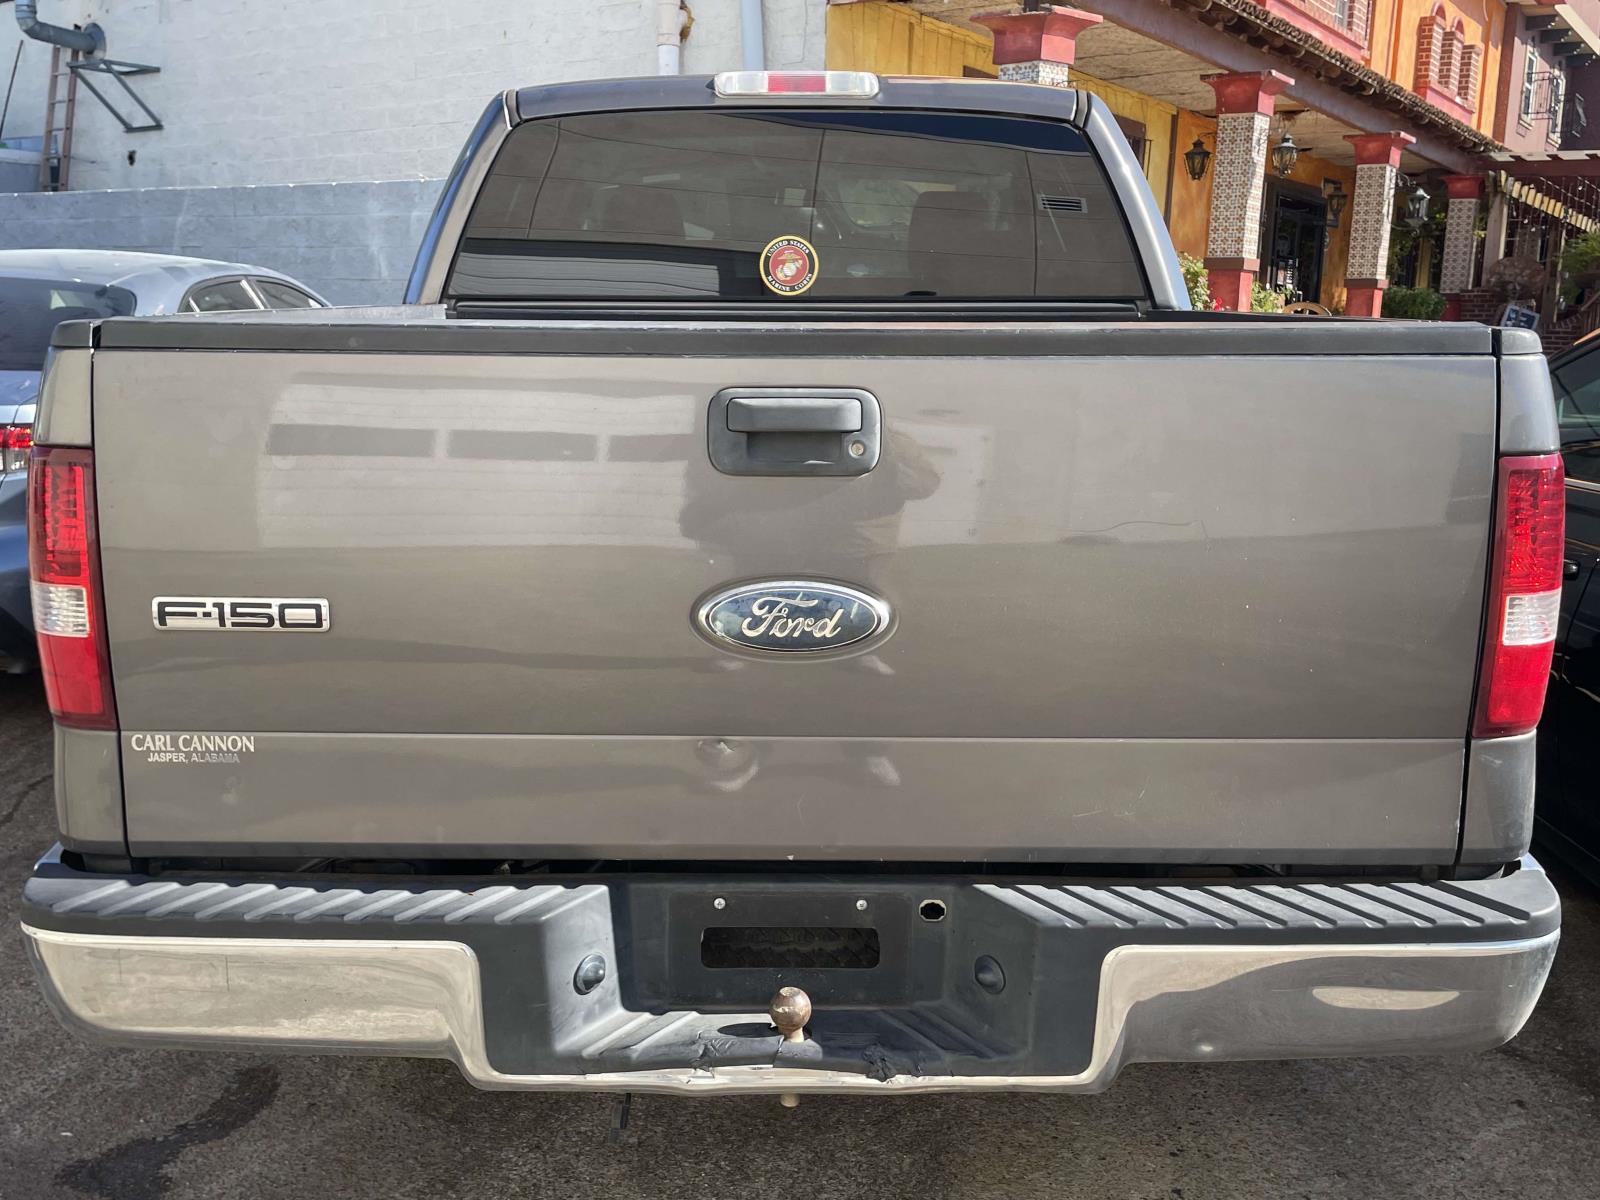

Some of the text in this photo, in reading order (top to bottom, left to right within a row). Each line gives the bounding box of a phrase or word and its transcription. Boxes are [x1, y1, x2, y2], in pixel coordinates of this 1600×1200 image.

[767, 240, 810, 257] UNITED STATES
[767, 273, 813, 291] MARINE CORPS
[157, 601, 324, 629] F-150
[741, 596, 842, 638] Ford
[131, 734, 255, 752] CARL CANNON
[147, 752, 240, 764] JASPER, ALABAMA
